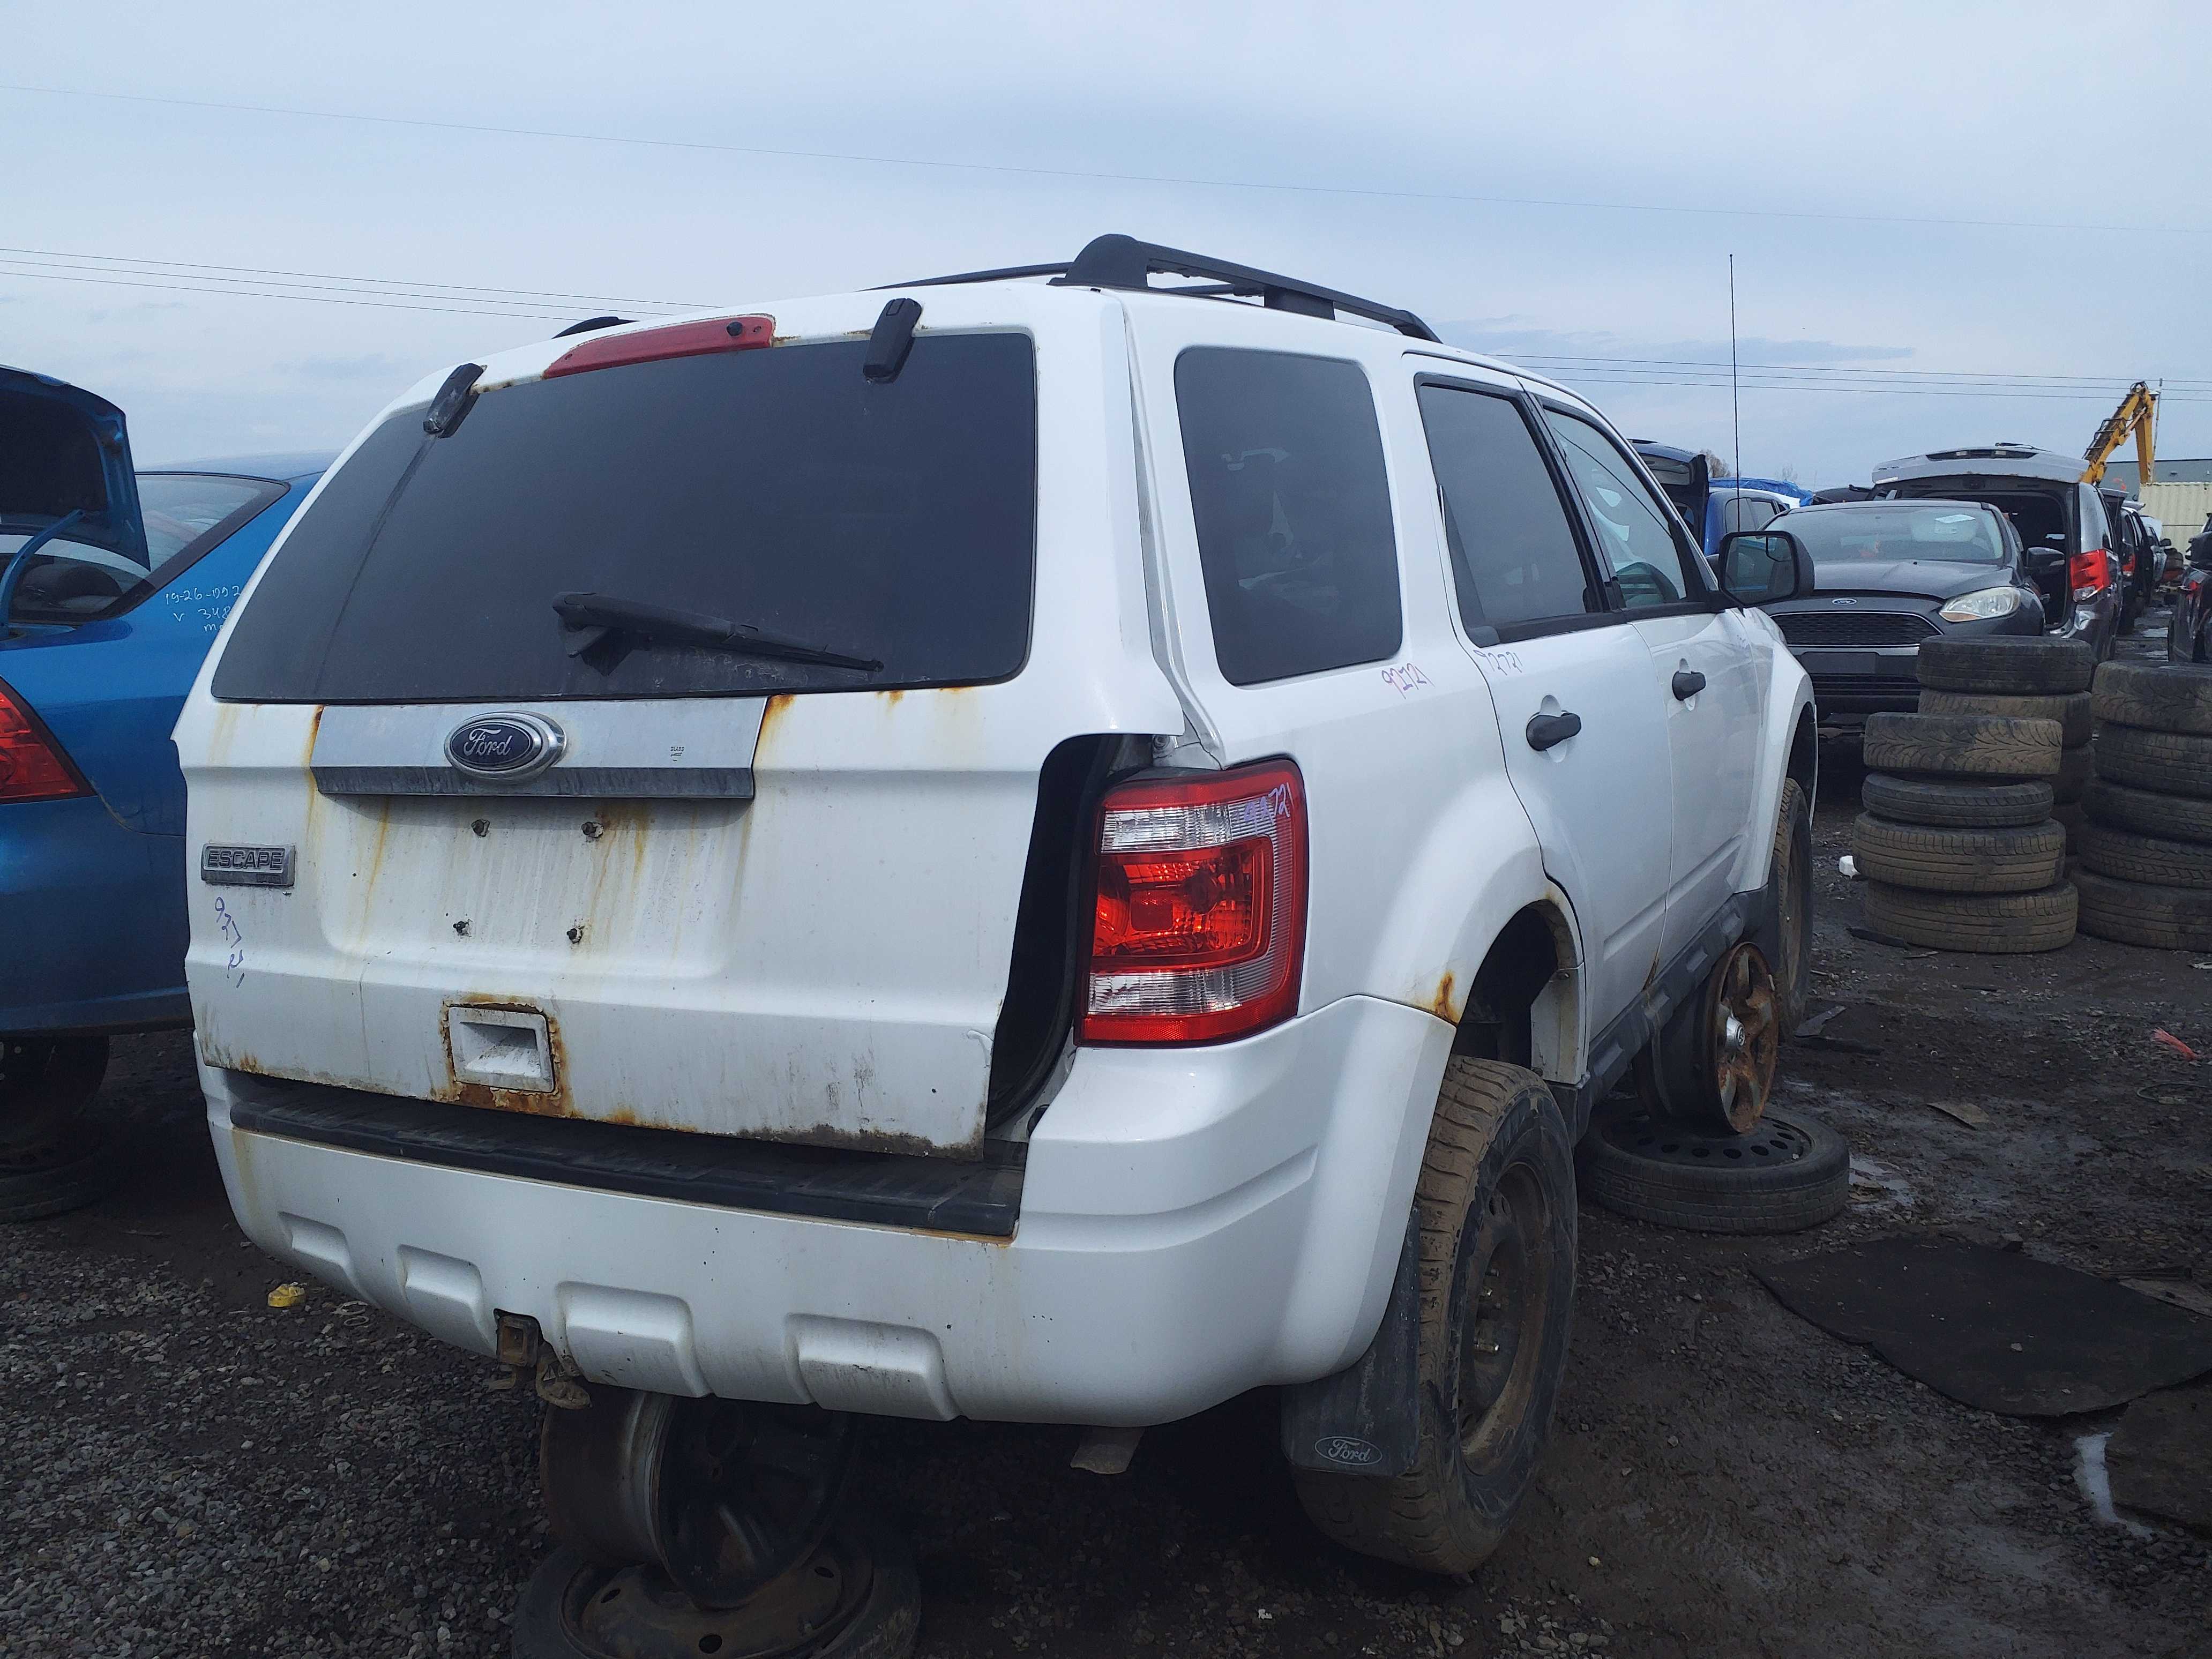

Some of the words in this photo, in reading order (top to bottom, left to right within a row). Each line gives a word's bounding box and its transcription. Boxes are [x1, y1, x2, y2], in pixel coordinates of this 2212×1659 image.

[463, 728, 513, 757] Ford
[207, 849, 284, 871] ESCAPE
[1328, 1439, 1372, 1462] Ford
